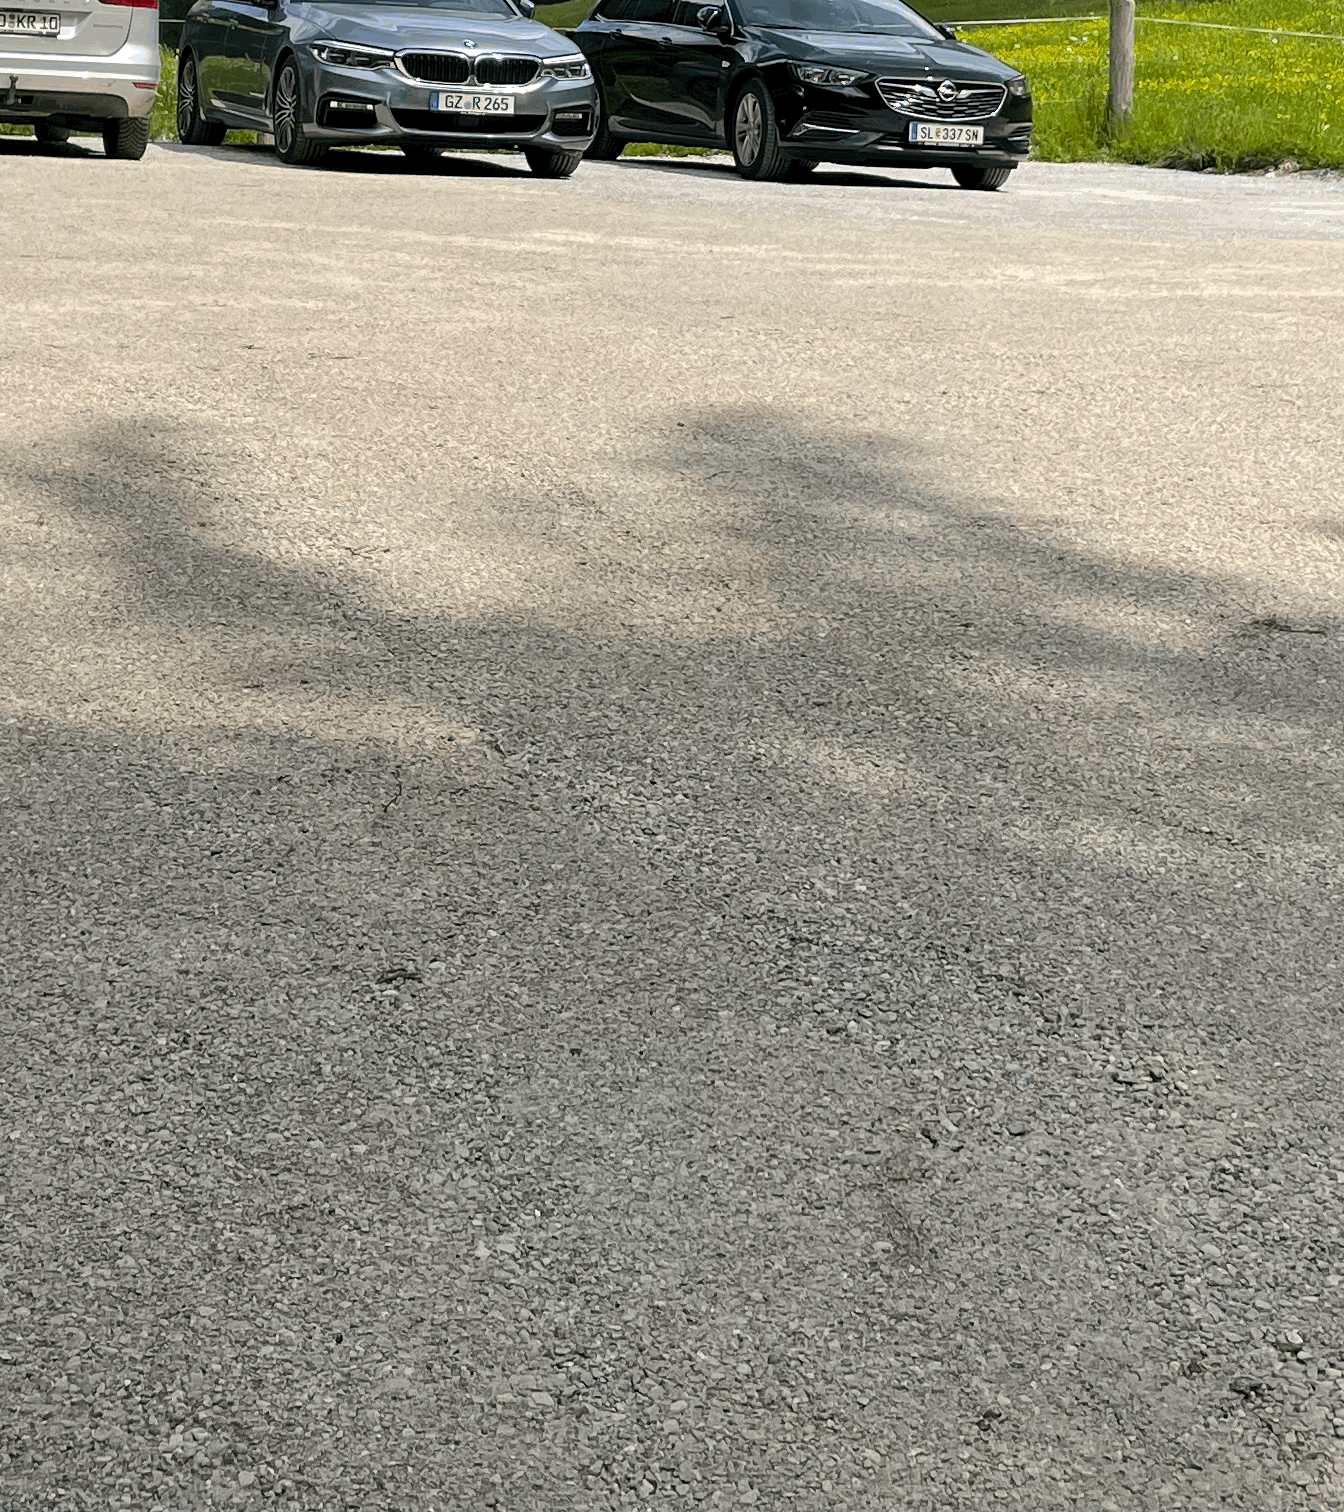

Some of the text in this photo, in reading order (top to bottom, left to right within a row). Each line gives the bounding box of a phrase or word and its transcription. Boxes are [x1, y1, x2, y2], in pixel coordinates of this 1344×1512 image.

[16, 15, 37, 29] KR
[40, 16, 57, 30] 10
[445, 95, 509, 111] GZ R 265
[920, 126, 979, 142] SL 337 SN
